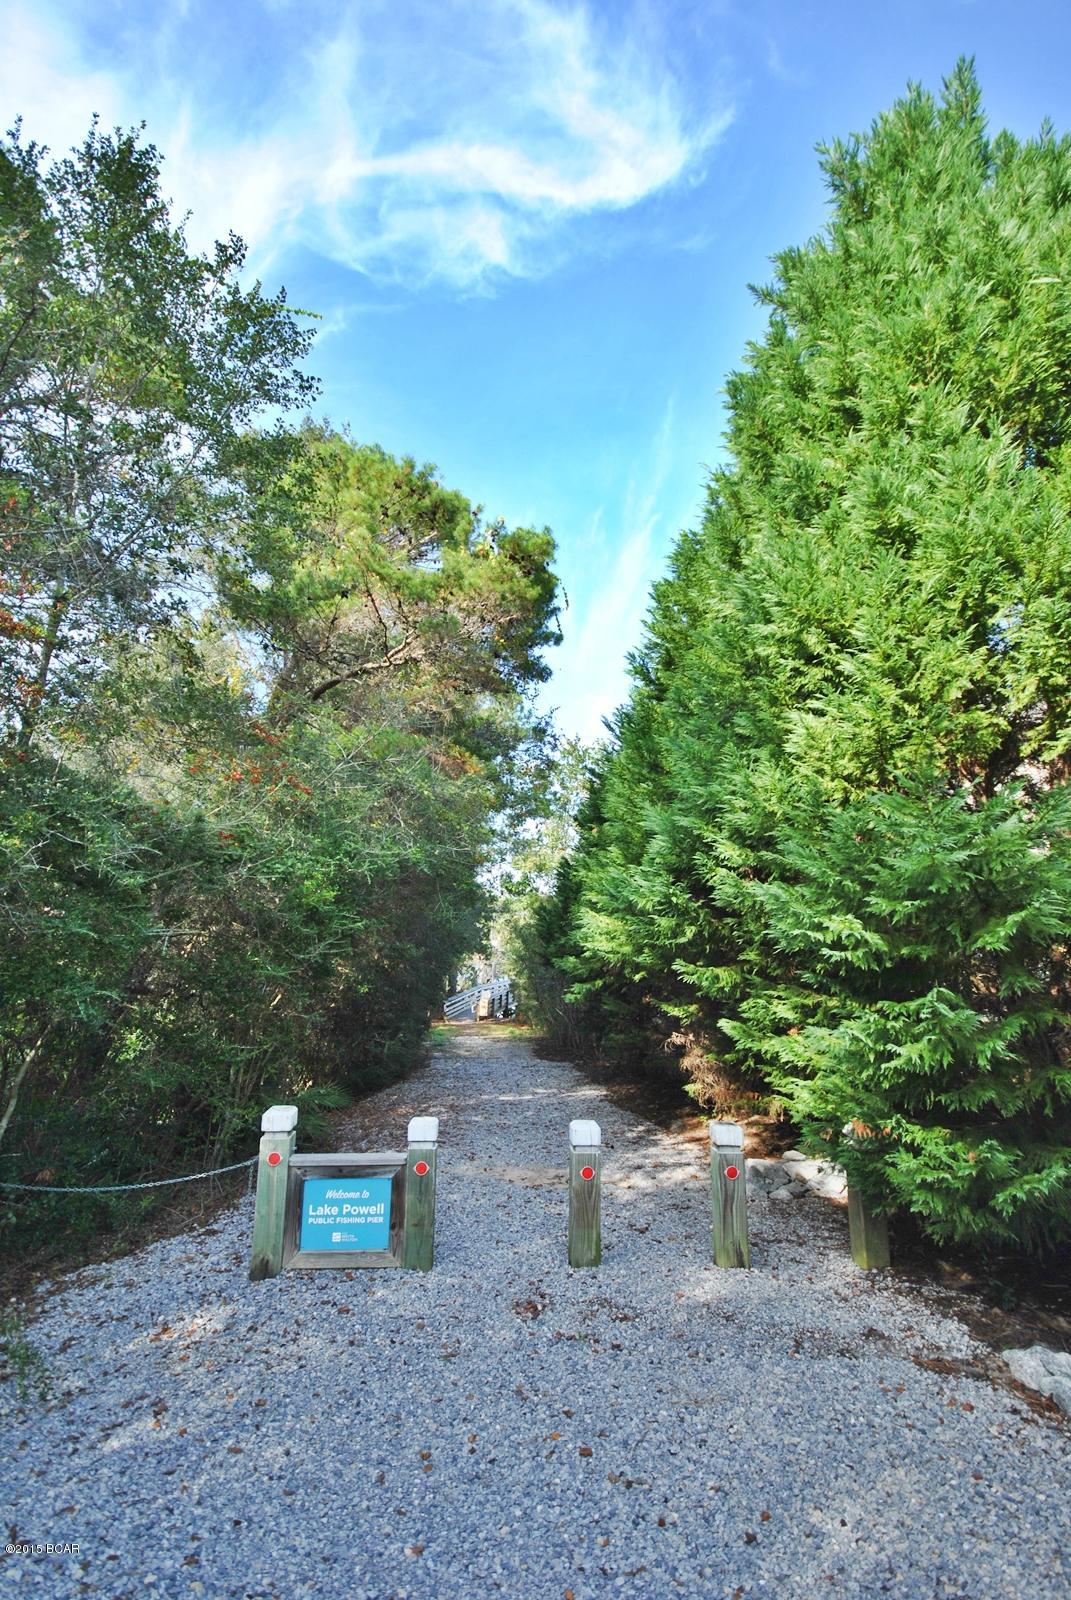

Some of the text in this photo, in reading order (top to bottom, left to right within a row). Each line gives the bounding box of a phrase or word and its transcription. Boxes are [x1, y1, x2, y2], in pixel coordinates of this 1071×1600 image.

[325, 1189, 370, 1199] Welcome to
[308, 1202, 384, 1215] Lake Powell
